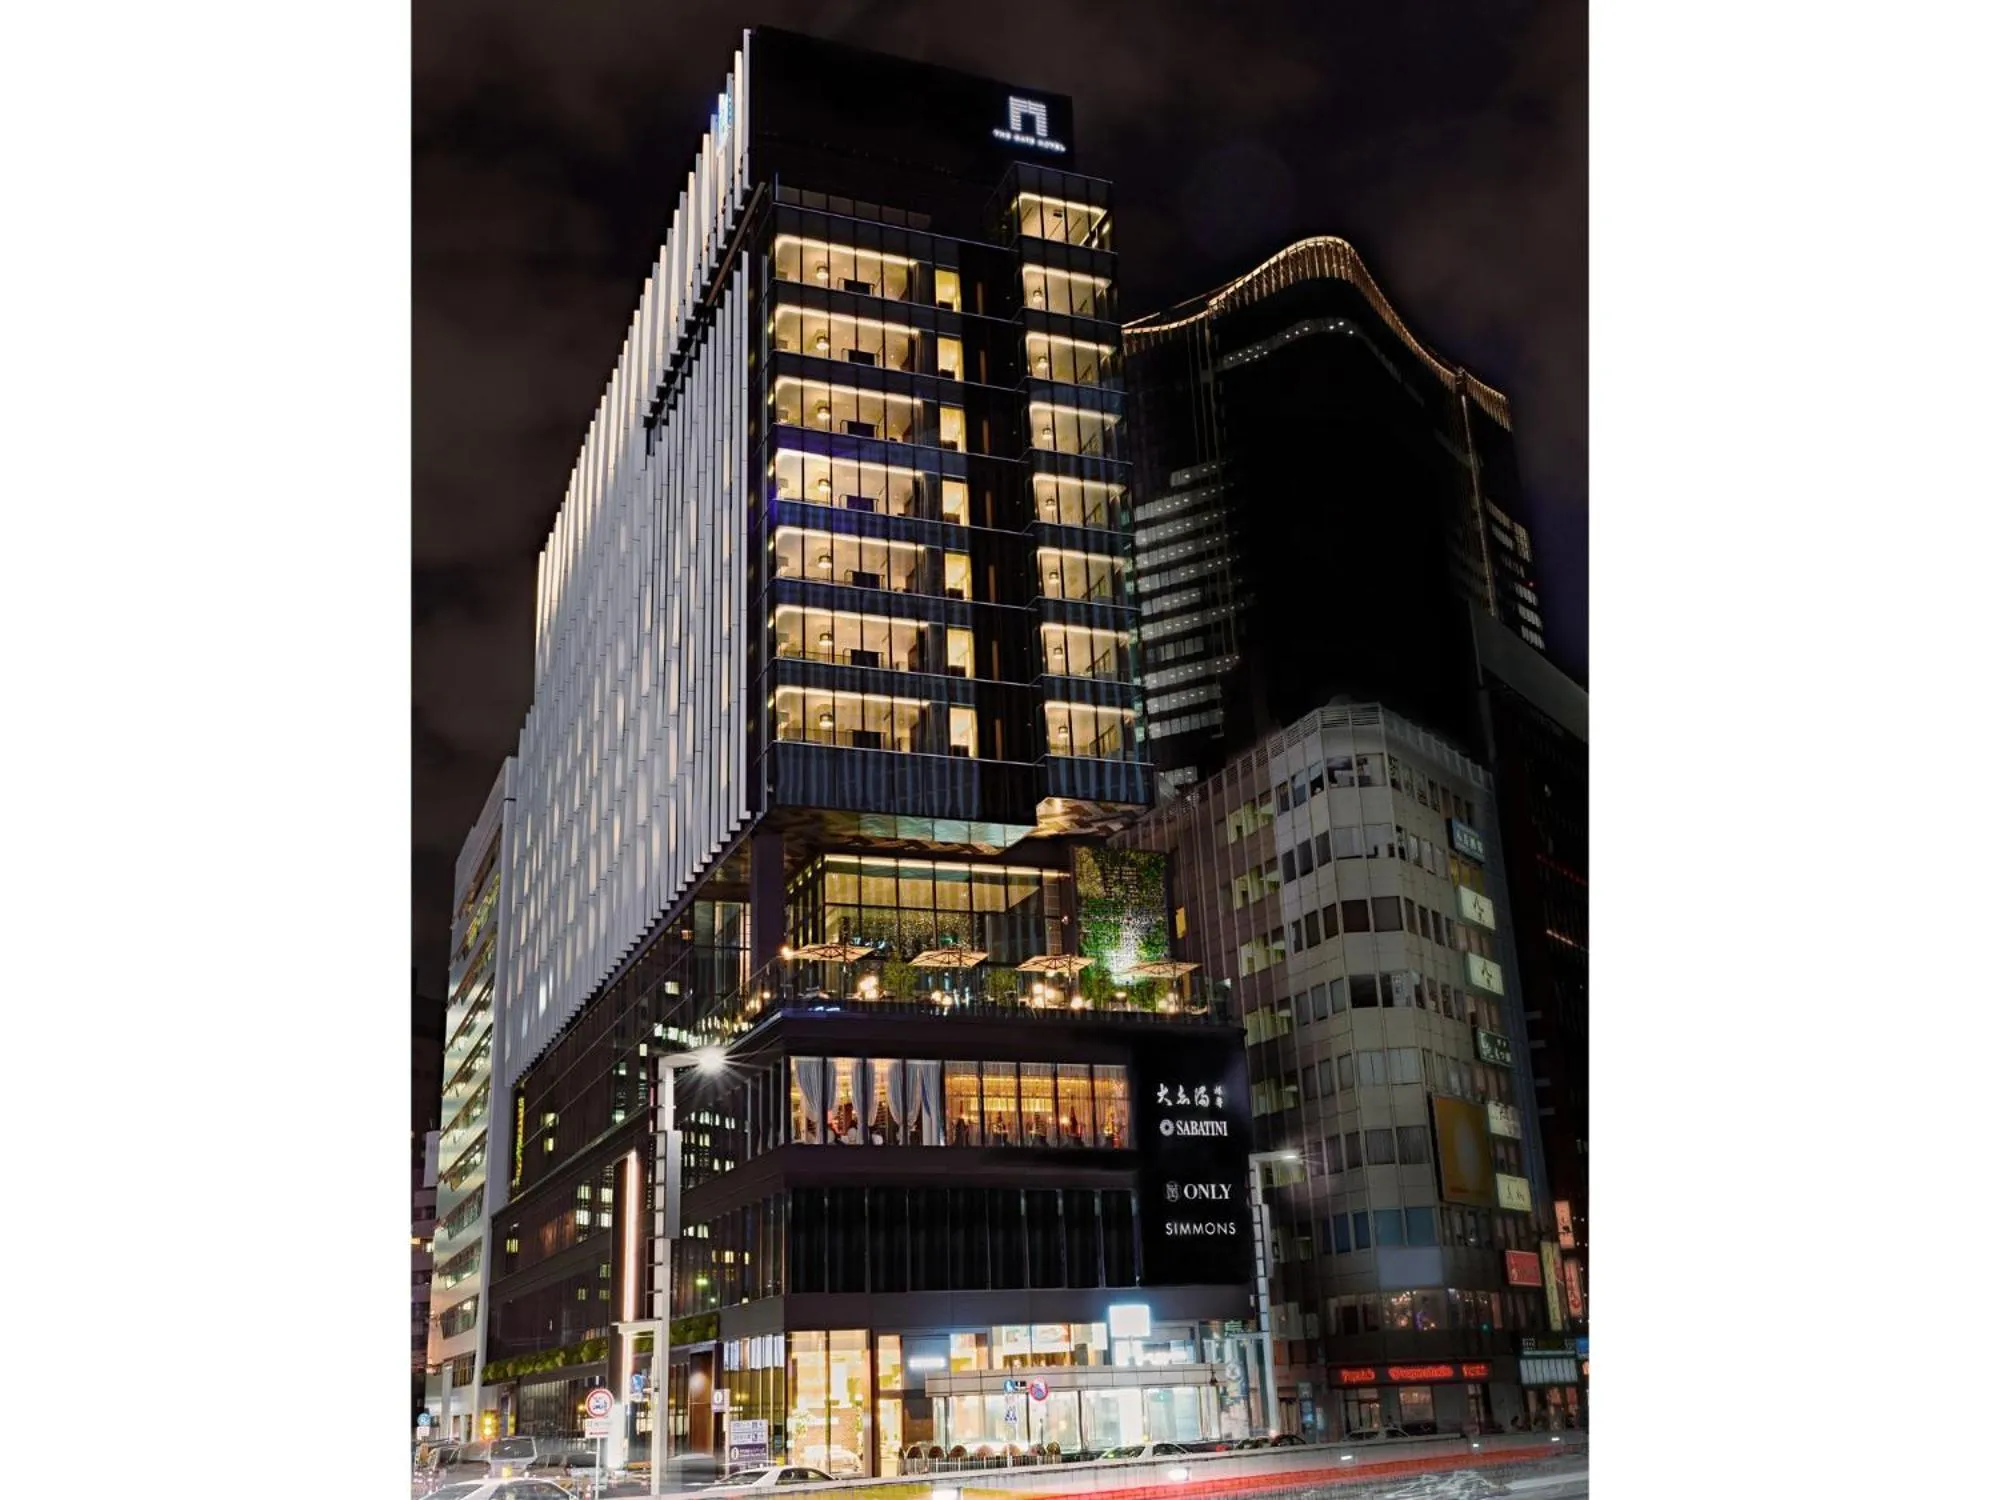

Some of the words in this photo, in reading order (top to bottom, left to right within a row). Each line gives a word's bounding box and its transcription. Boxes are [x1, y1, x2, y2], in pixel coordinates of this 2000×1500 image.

[1175, 1119, 1228, 1137] SABATINI
[1183, 1183, 1232, 1200] ONLY
[1165, 1221, 1237, 1236] SIMMONS
